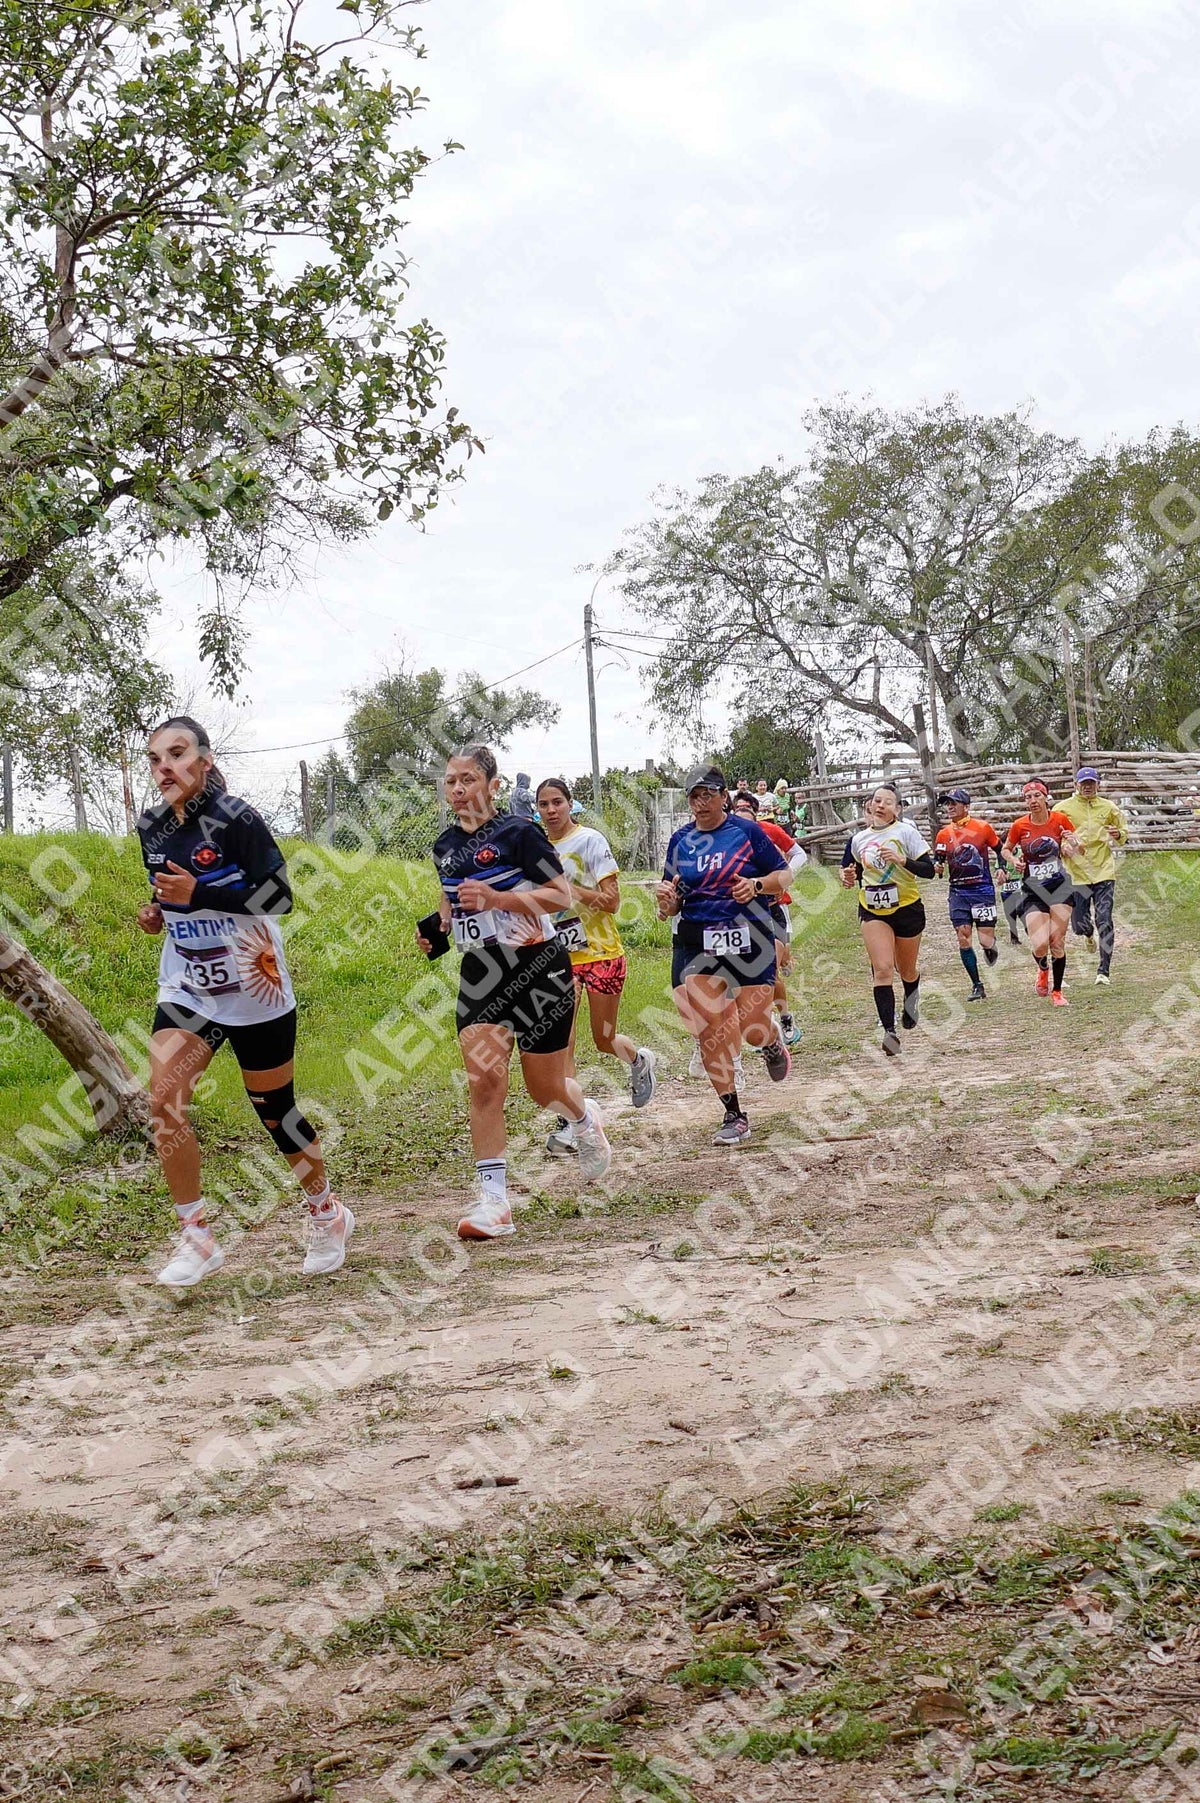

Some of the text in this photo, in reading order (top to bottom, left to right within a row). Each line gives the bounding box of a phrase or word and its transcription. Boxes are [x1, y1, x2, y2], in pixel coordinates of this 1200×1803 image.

[1033, 864, 1055, 875] 232
[873, 891, 890, 904] 44
[976, 908, 993, 918] 231
[712, 931, 742, 949] 218
[184, 961, 229, 987] 435
